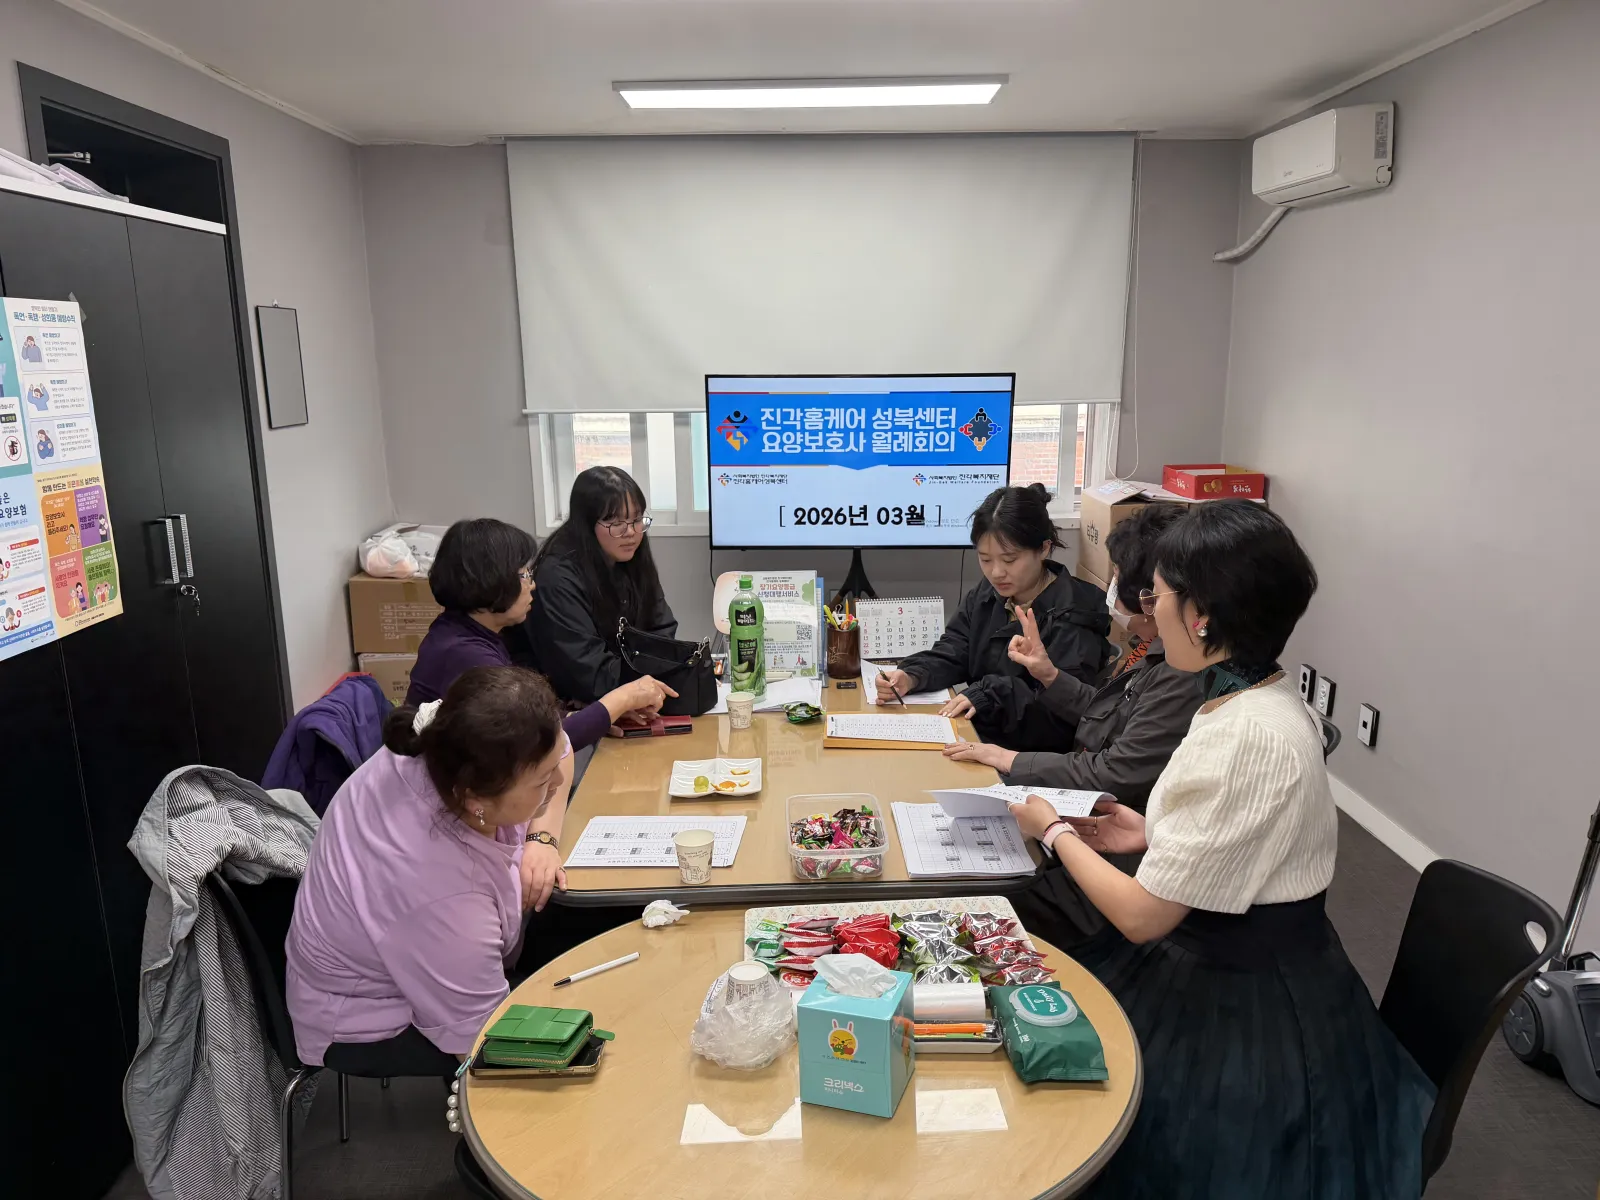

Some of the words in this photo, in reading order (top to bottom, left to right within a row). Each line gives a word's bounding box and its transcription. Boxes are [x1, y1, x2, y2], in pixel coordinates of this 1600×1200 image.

[760, 407, 866, 431] 진각홈케어
[871, 407, 957, 430] 성북센터
[761, 431, 867, 453] 요양보호사
[871, 431, 955, 454] 월례회의
[958, 473, 1000, 481] 진각복지재단
[793, 504, 870, 526] 2026년
[876, 504, 926, 526] 03월
[760, 583, 796, 591] 장기요양등급
[758, 590, 800, 598] 신청대행서비스
[898, 607, 904, 615] 3
[824, 1077, 864, 1093] 크리넥스
